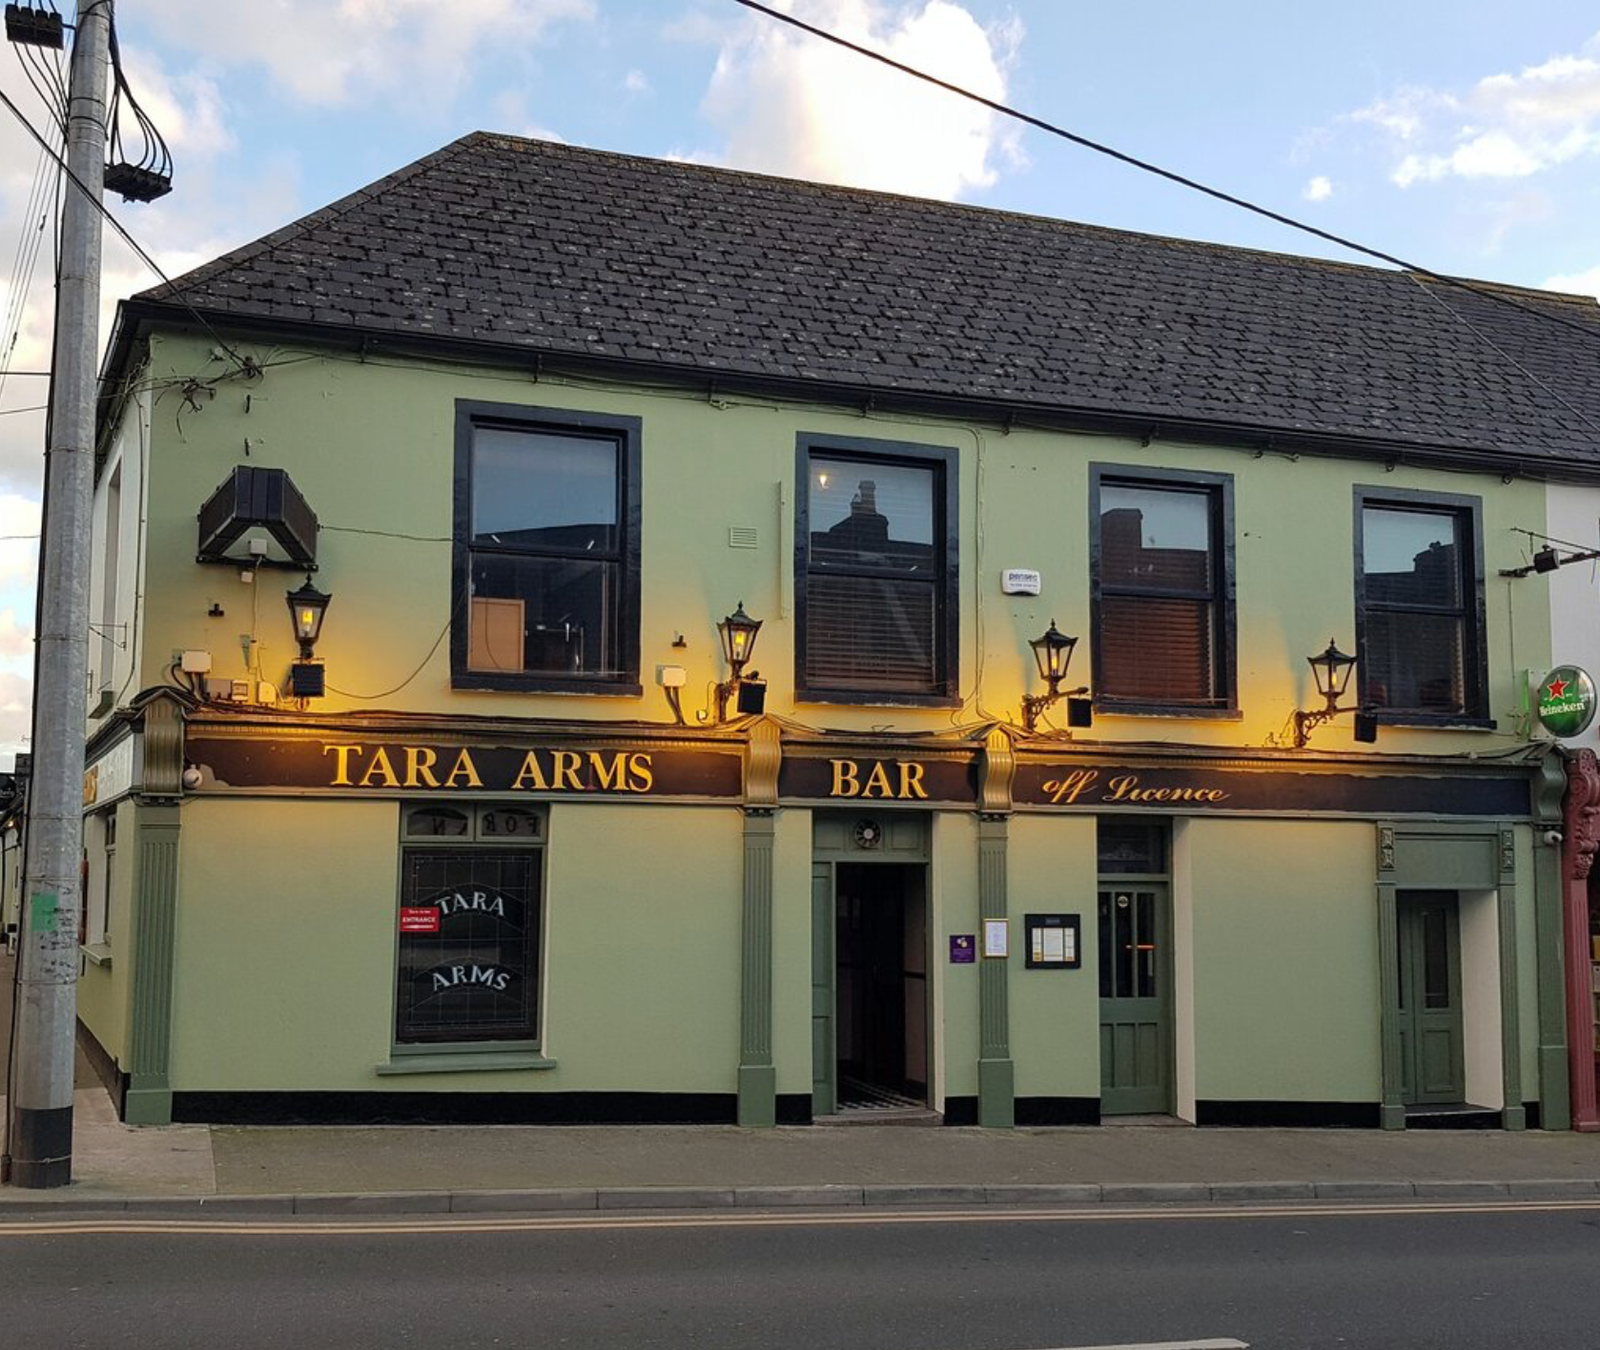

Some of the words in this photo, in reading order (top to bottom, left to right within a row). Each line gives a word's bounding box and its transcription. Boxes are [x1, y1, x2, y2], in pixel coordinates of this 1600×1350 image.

[1539, 701, 1586, 717] Heineken
[323, 744, 484, 787] TARA
[510, 749, 653, 792] ARMS
[828, 759, 929, 799] BAR
[1041, 769, 1098, 804] off
[1101, 774, 1232, 802] Licence
[434, 891, 505, 917] TARA
[432, 964, 511, 991] ARMS
